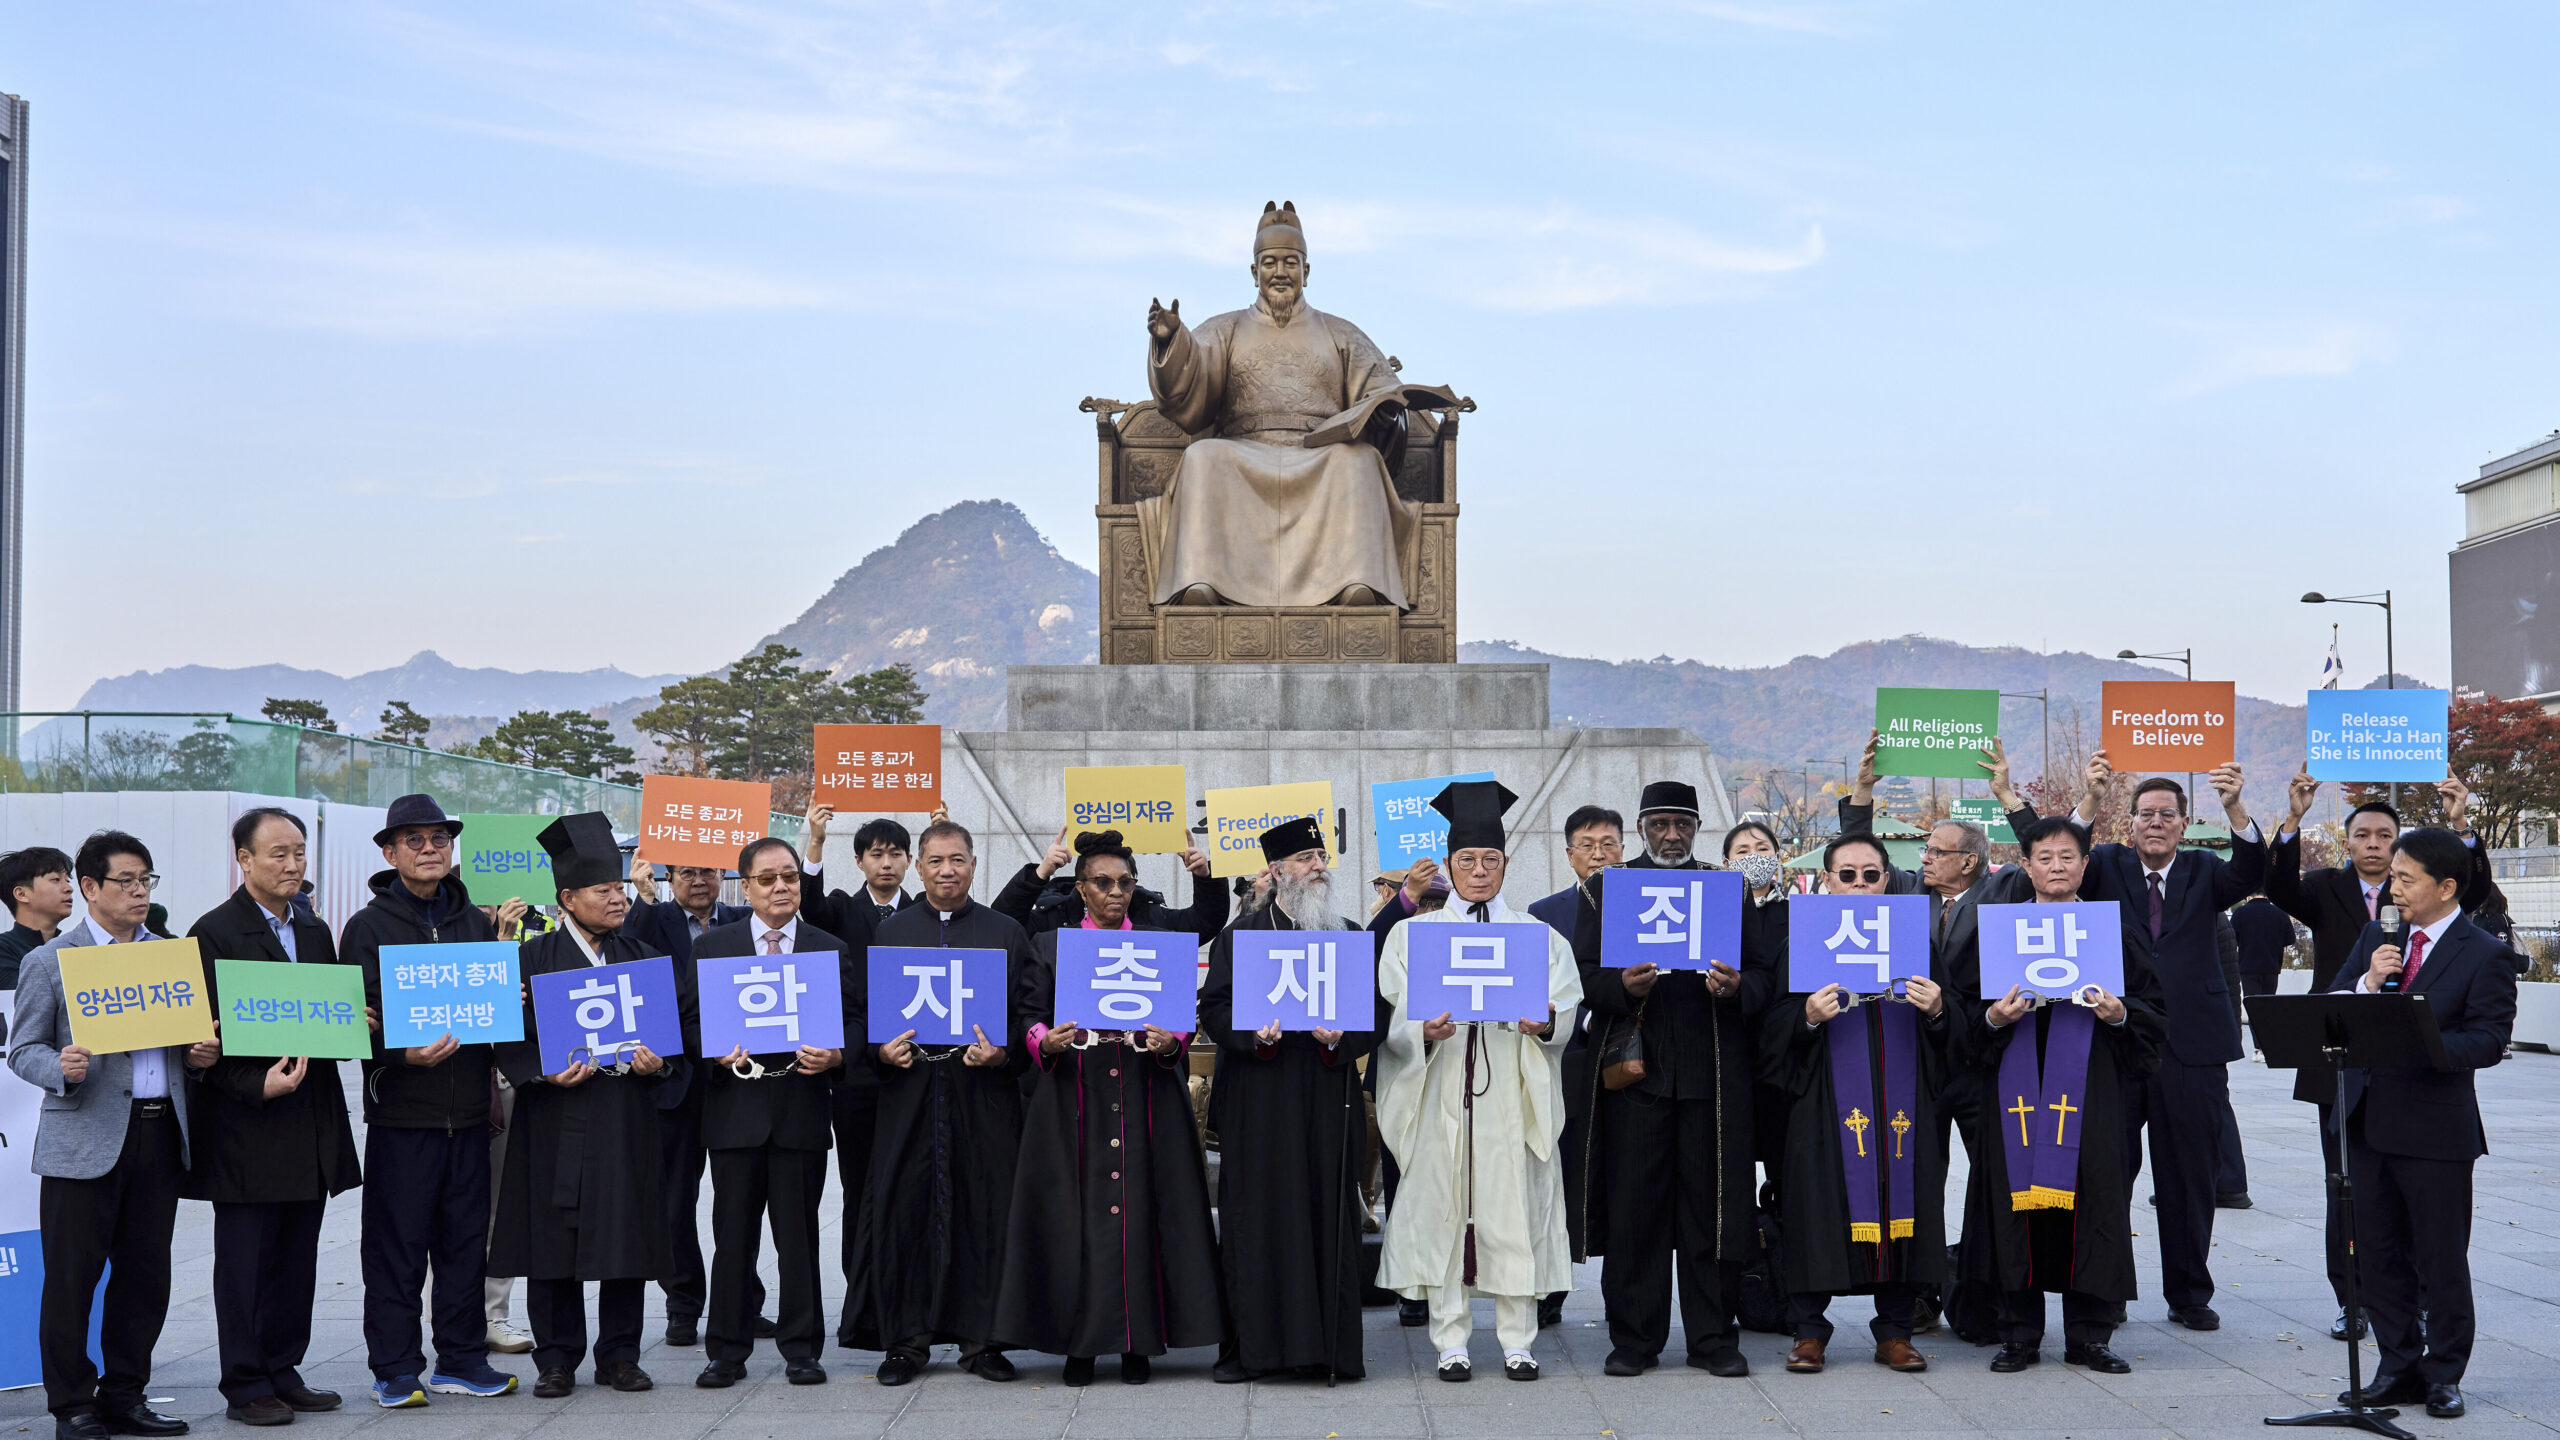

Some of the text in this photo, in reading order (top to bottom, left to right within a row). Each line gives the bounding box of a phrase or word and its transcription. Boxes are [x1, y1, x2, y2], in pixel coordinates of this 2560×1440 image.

[1889, 718, 1983, 735] All Religions
[2112, 709, 2225, 727] Freedom to
[2342, 712, 2409, 727] Release
[1877, 734, 1993, 750] Share One Path
[2133, 729, 2204, 745] Believe
[2311, 729, 2441, 744] Dr. Hak-Ja Han
[837, 751, 914, 766] 모든 종교가
[2311, 746, 2442, 760] She is Innocent
[823, 773, 932, 788] 나가는 길은 한길
[665, 804, 742, 823] 모든 종교가
[1074, 802, 1130, 824] 양심의
[1135, 801, 1174, 823] 자유
[648, 824, 692, 841] 나가는
[698, 828, 726, 844] 길은
[472, 850, 531, 873] 신앙의
[1638, 881, 1702, 959] 죄
[1824, 906, 1890, 983] 석
[2016, 913, 2087, 988] 방
[395, 961, 507, 989] 한학자 총재
[1091, 942, 1162, 1021] 총
[1267, 942, 1337, 1020] 재
[1443, 937, 1513, 1010] 무
[77, 981, 194, 1016] 양심의 자유
[733, 964, 807, 1042] 학
[900, 959, 975, 1036] 자
[233, 998, 355, 1024] 신앙의 자유
[409, 1002, 494, 1030] 무죄석방
[569, 973, 644, 1055] 한
